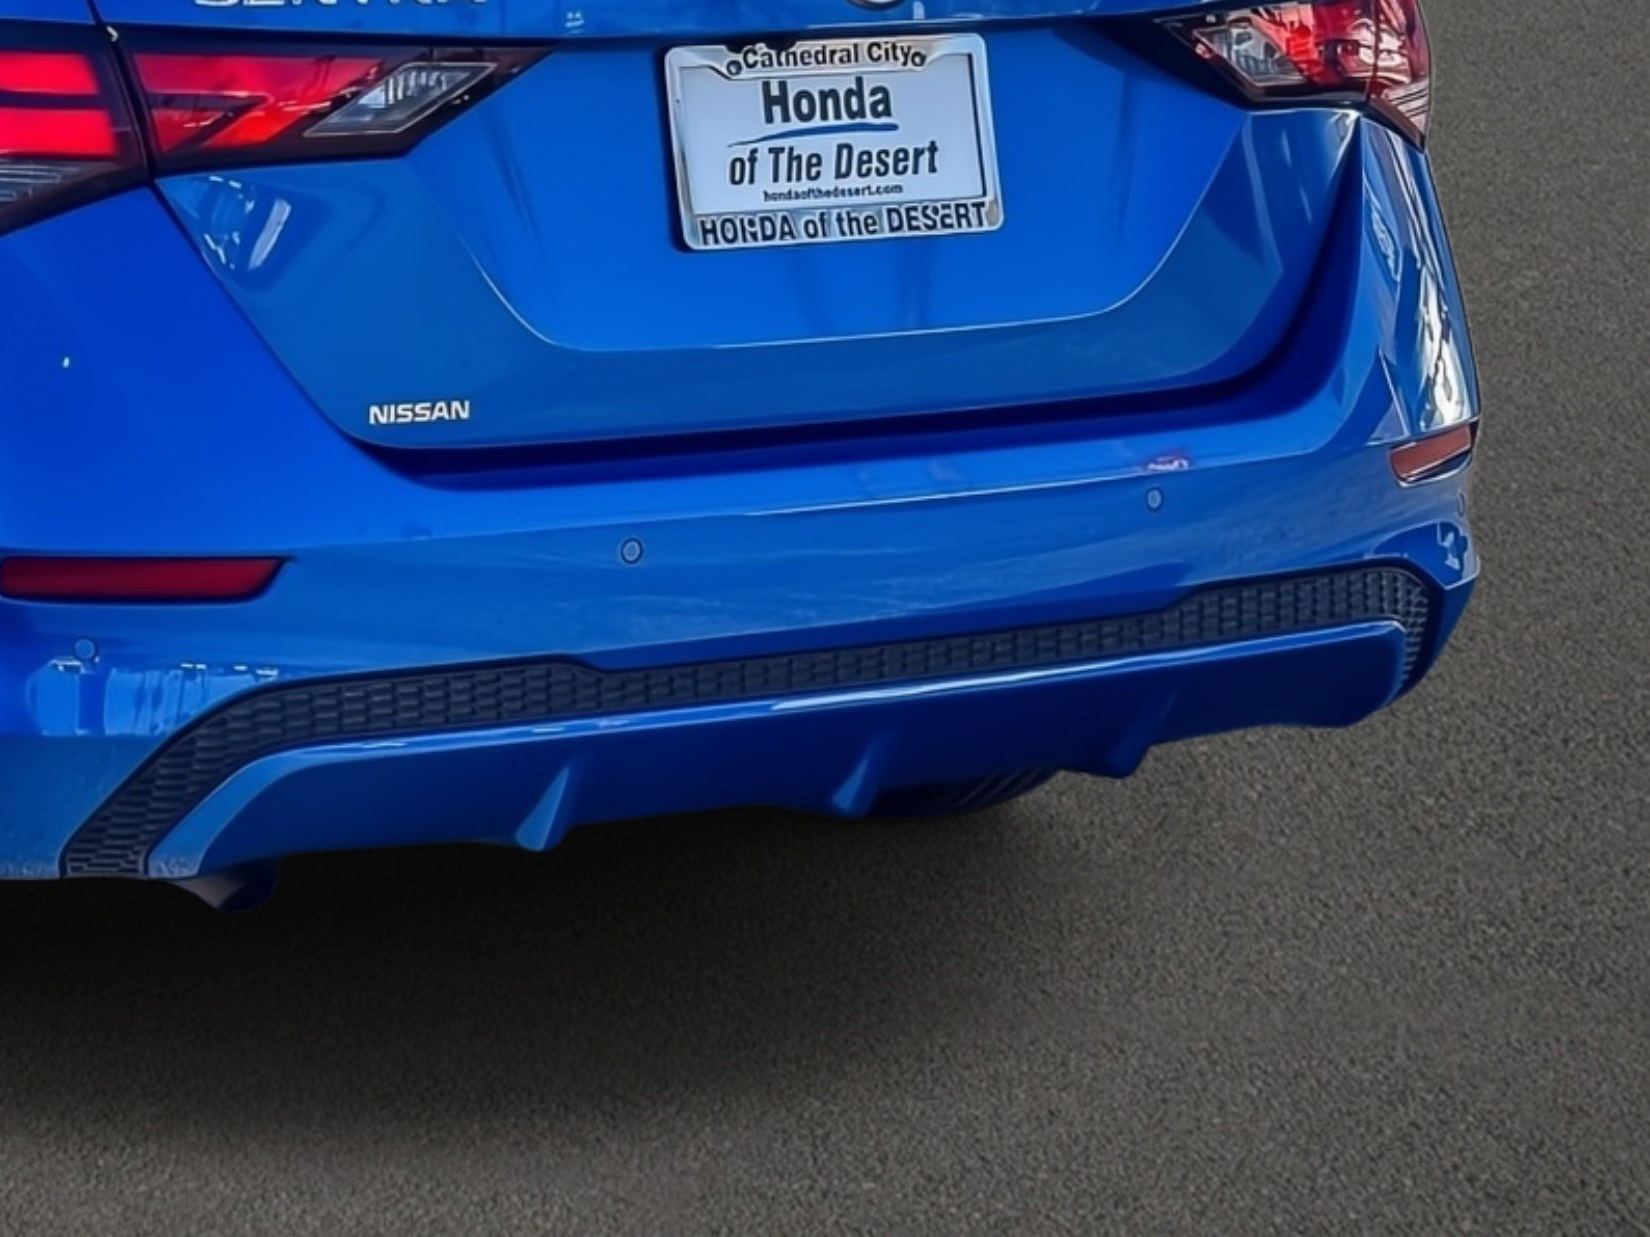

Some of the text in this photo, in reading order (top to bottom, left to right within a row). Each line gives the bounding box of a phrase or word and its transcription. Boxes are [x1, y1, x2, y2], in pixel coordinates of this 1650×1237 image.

[867, 41, 912, 66] City
[761, 76, 893, 124] Honda
[729, 140, 939, 185] of The Desert
[699, 201, 986, 246] HONDA of the DESERT
[369, 400, 470, 424] NISSAN
